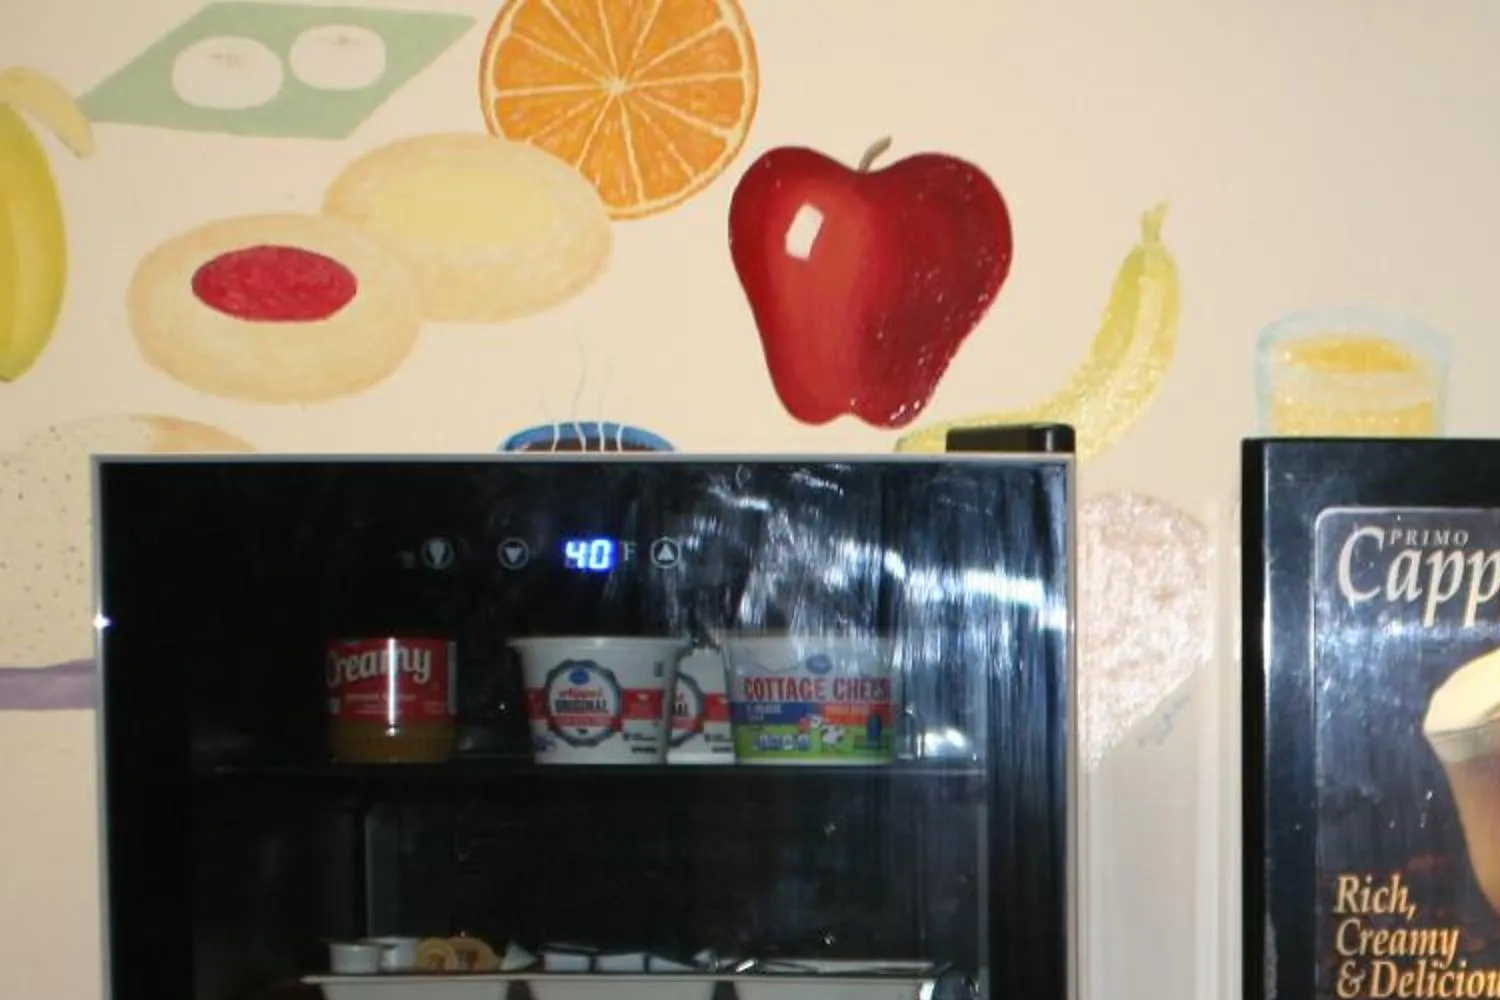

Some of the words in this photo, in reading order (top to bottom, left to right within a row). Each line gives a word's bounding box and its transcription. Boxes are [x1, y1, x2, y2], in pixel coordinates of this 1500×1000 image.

[565, 538, 612, 570] 40
[1389, 528, 1469, 548] PRIMO
[744, 676, 826, 702] COTTAGE
[1334, 873, 1417, 920] Rich,
[1336, 918, 1459, 968] Creamy
[1336, 960, 1365, 999] &
